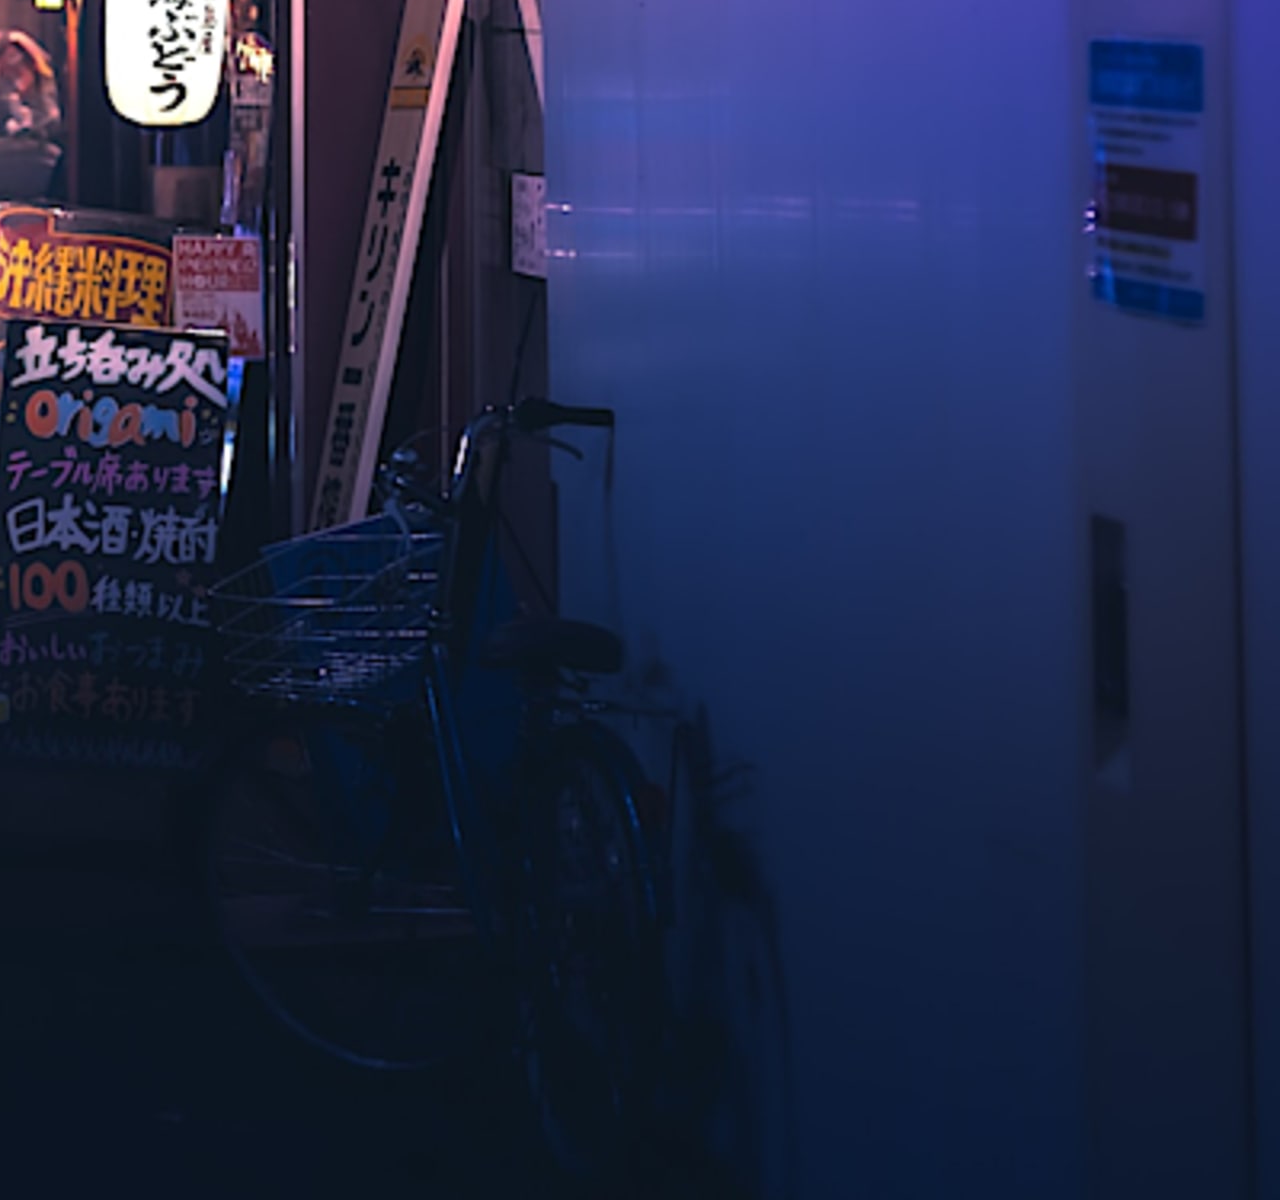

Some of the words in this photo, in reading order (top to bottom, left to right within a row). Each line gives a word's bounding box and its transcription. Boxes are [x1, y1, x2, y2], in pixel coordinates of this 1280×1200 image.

[11, 327, 228, 409] 立ち呑み処
[7, 446, 217, 499] テーブル席あります
